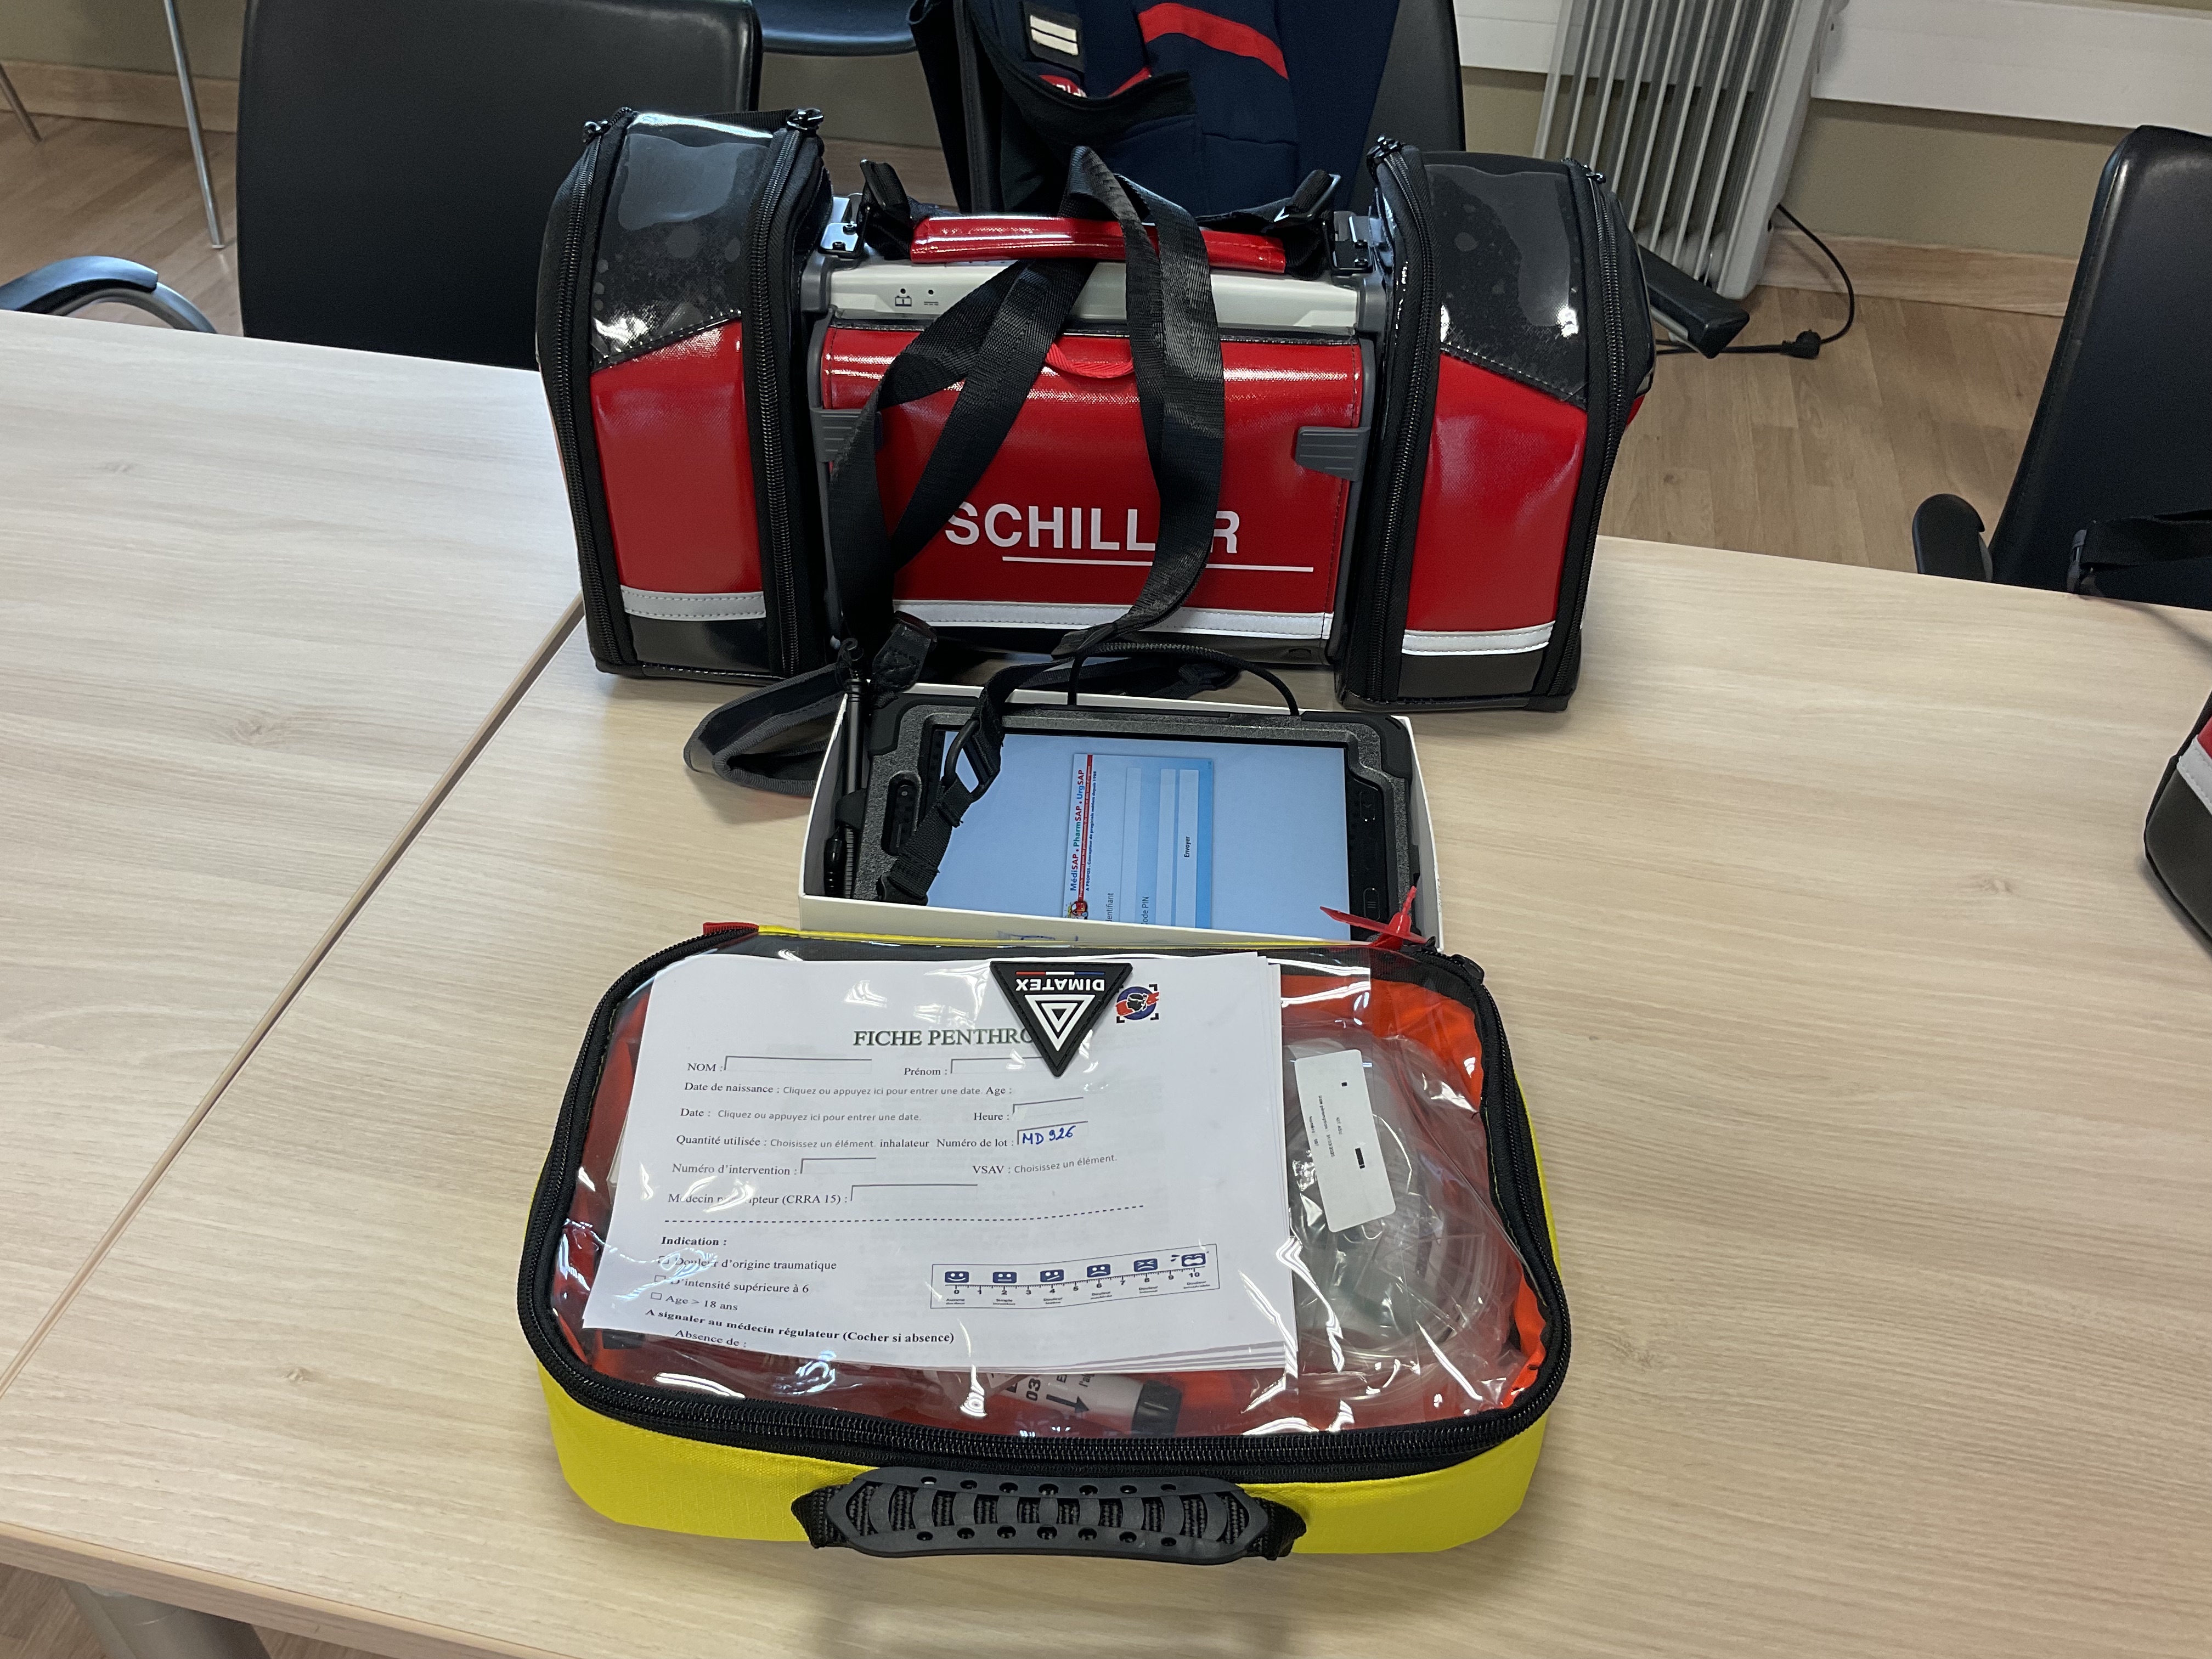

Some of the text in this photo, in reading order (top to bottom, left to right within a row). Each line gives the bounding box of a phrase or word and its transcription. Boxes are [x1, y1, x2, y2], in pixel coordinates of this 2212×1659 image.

[945, 501, 1239, 553] SCHILLR
[1070, 770, 1085, 891] MédiSAP PharmSAP UrgSAP
[1105, 893, 1114, 921] entifiant
[1015, 978, 1105, 991] DIMATEX
[853, 1030, 922, 1046] FICHE
[687, 1063, 716, 1071] NOM
[685, 1082, 708, 1091] Date
[710, 1083, 723, 1091] de
[726, 1084, 774, 1093] naissance
[783, 1086, 816, 1095] Cliquez
[986, 1087, 1006, 1096] Age
[680, 1108, 704, 1117] Date
[718, 1110, 752, 1119] Cliquez
[769, 1113, 808, 1122] appuyez
[676, 1135, 720, 1146] Quantité
[724, 1136, 760, 1146] utilisée
[770, 1139, 817, 1148] Choisissez
[880, 1139, 930, 1148] inhalateur
[936, 1138, 977, 1147] Numéro
[1022, 1132, 1044, 1145] MD
[672, 1163, 714, 1173] Numéro
[718, 1165, 790, 1175] d'intervention
[973, 1165, 1005, 1174] VSAV
[1014, 1163, 1060, 1173] Choisissez
[1077, 1154, 1118, 1166] élément.
[782, 1194, 820, 1205] (CRRA
[825, 1194, 840, 1205] 15)
[661, 1236, 719, 1246] Indication
[721, 1259, 770, 1271] d'origine
[774, 1261, 837, 1272] traumatique
[733, 1282, 789, 1293] supérieure
[793, 1284, 798, 1293] à
[802, 1284, 809, 1293] 6
[665, 1295, 689, 1305] Age
[704, 1300, 716, 1308] 18
[658, 1311, 706, 1324] signaler
[726, 1322, 774, 1334] médecin
[778, 1328, 839, 1339] régulateur
[843, 1331, 889, 1342] (Cocher
[892, 1333, 901, 1342] si
[905, 1332, 954, 1344] absence)
[675, 1329, 723, 1344] Absence
[726, 1338, 740, 1346] de
[1026, 1378, 1041, 1401] 03
